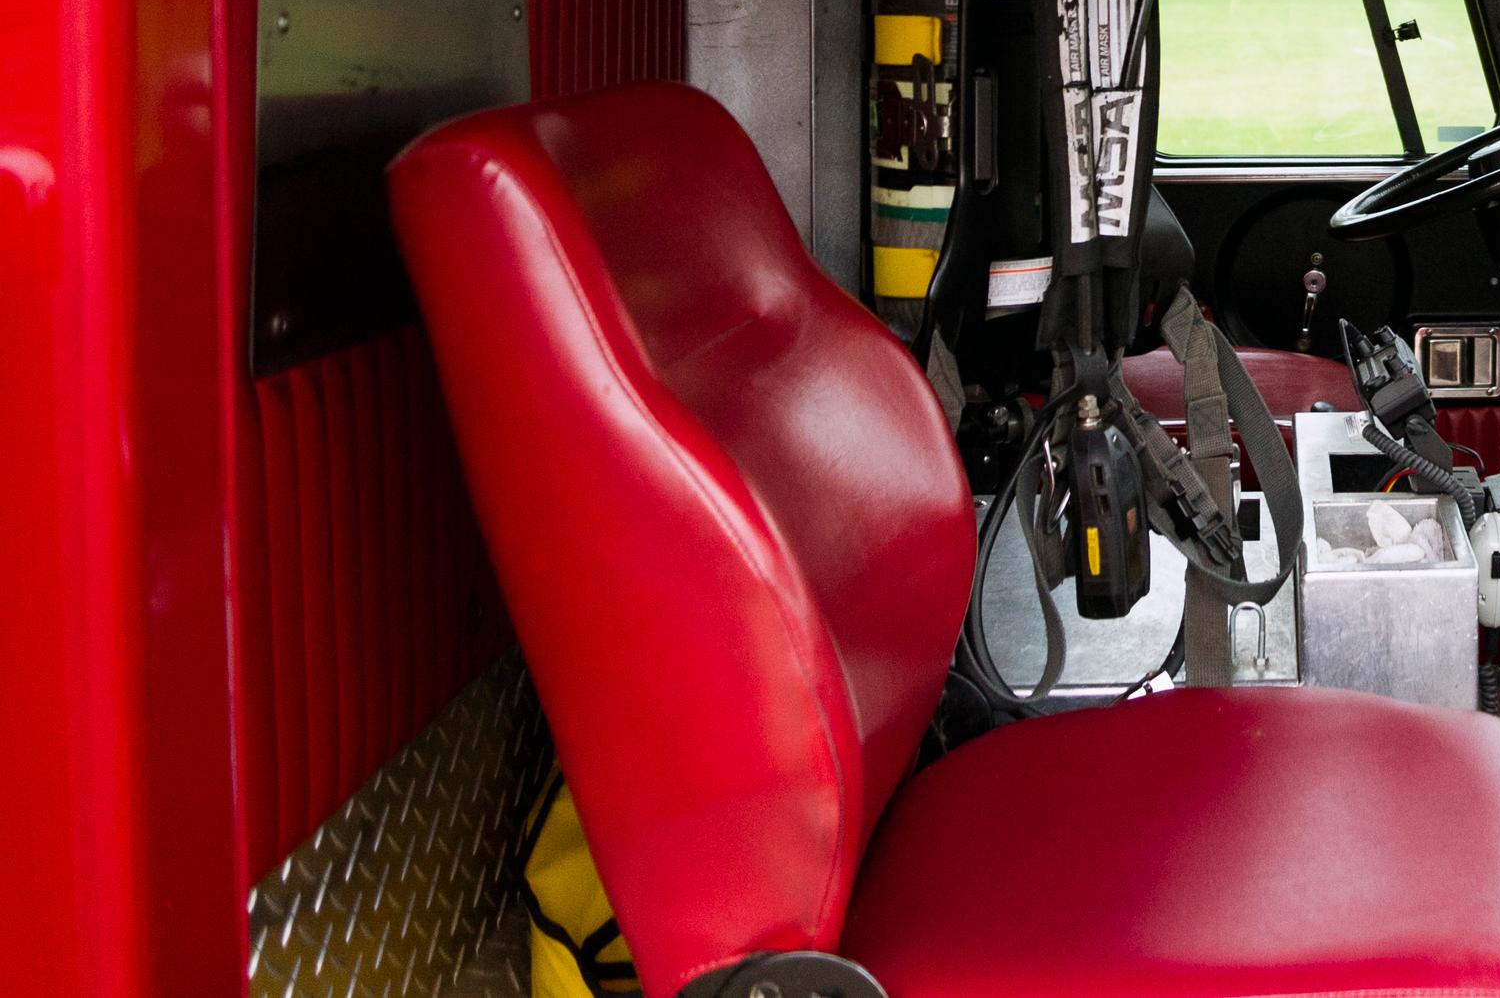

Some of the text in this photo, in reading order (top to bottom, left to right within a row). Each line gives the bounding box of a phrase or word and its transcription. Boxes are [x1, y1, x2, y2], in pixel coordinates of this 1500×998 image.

[1070, 52, 1081, 71] AIR
[1099, 25, 1111, 76] AIR MASK
[1096, 95, 1135, 228] MSA
